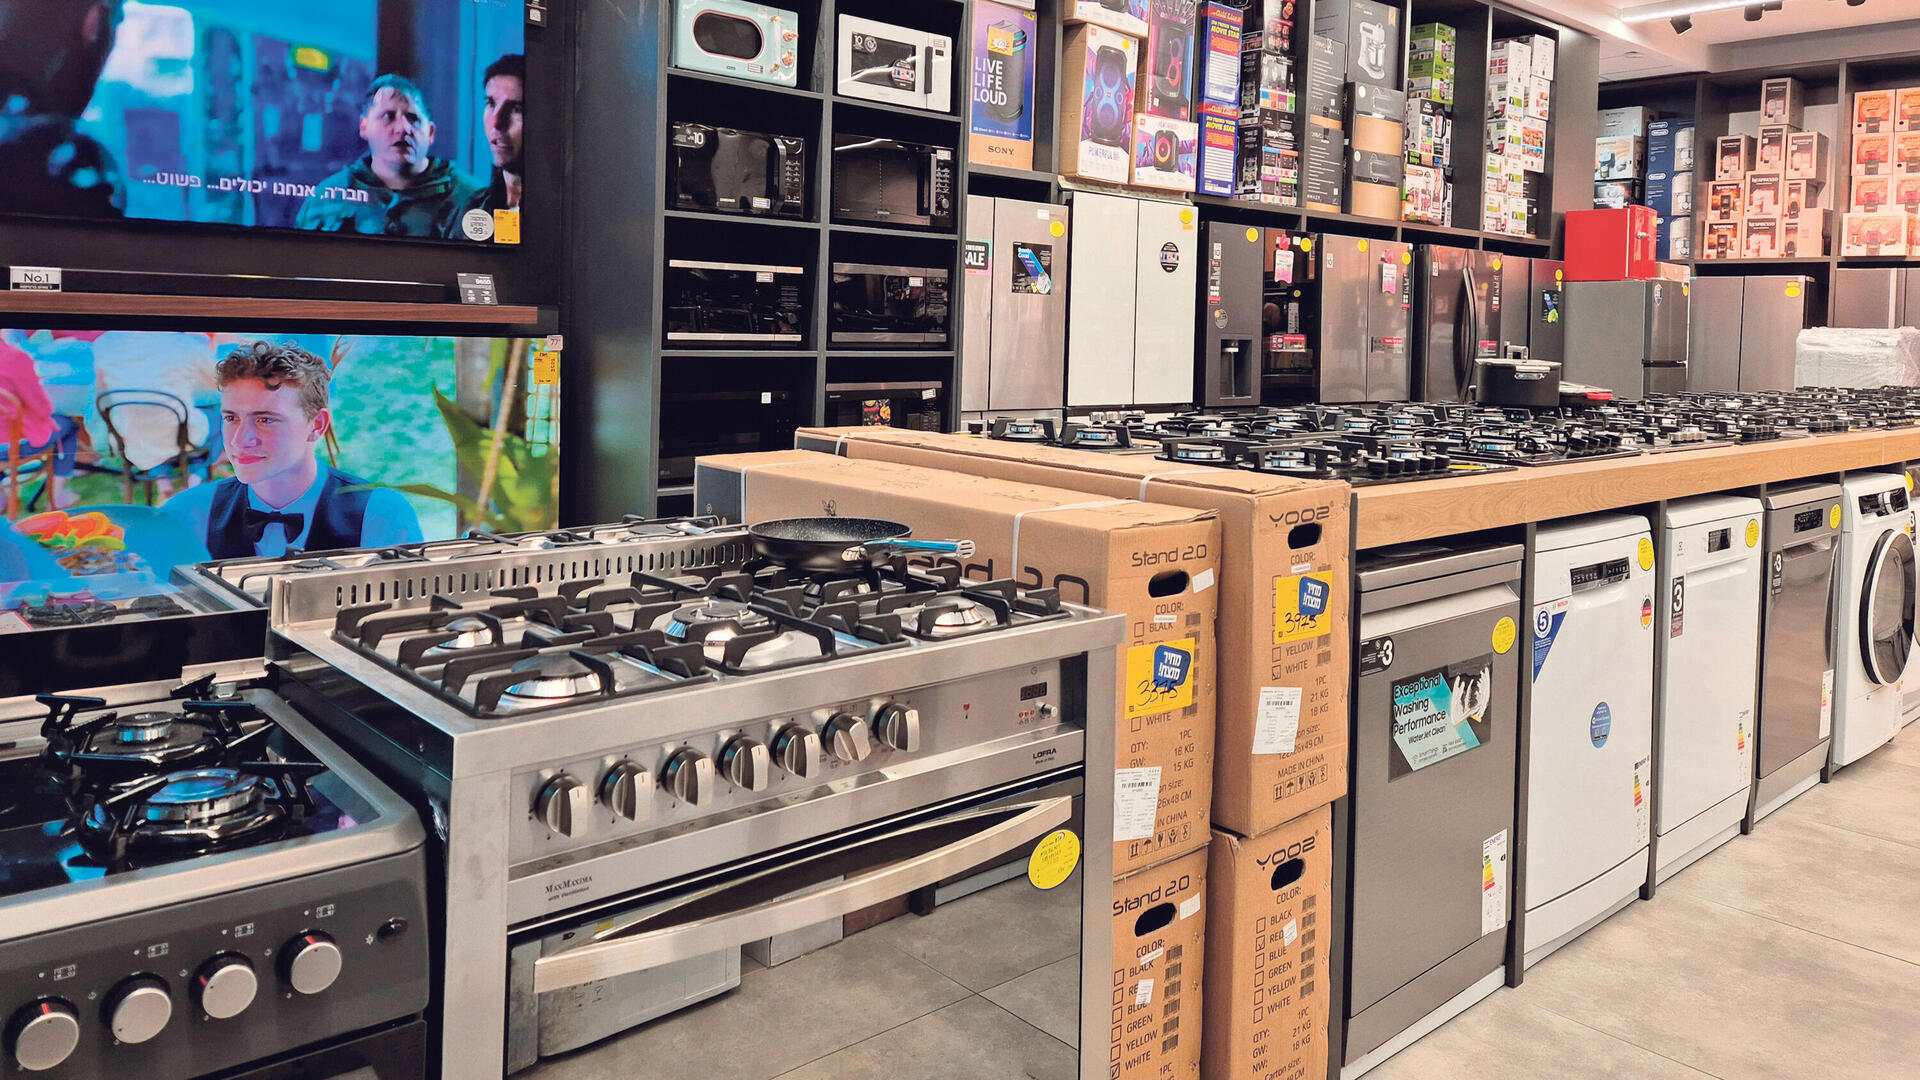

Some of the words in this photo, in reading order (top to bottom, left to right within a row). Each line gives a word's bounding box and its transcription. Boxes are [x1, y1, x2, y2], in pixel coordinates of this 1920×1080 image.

[854, 35, 863, 45] 10
[974, 56, 1004, 75] LIVE
[974, 72, 1003, 91] LIFE
[973, 89, 1008, 106] LOUD
[692, 132, 704, 145] 10
[988, 146, 1014, 156] SONY
[143, 171, 202, 188] פשוט...
[207, 176, 268, 194] יכולים...
[272, 181, 316, 197] אנחנו
[965, 244, 986, 252] AMSUNG
[24, 273, 49, 283] No.1
[1131, 547, 1178, 567] Stand
[1182, 544, 1208, 561] 2.0
[1290, 552, 1316, 566] COLOR:
[1775, 554, 1782, 572] 3
[1307, 582, 1322, 598] מחיר
[1673, 584, 1684, 612] 3
[1155, 602, 1184, 615] COLOR:
[1302, 593, 1321, 610] מנצח!
[1539, 612, 1547, 627] 5
[1149, 623, 1174, 633] BLACK
[1285, 640, 1314, 657] YELLOW
[1382, 639, 1393, 666] 3
[1163, 651, 1182, 667] מחיר
[1285, 659, 1309, 674] WHITE
[1158, 662, 1180, 680] מנצח!
[1315, 675, 1327, 687] 1PC
[1394, 673, 1442, 699] Exceptional
[1310, 692, 1318, 703] 21
[1319, 688, 1329, 699] KG
[1310, 708, 1318, 717] 18
[1319, 703, 1329, 714] KG
[1393, 697, 1429, 718] Washing
[1146, 712, 1172, 726] WHITE
[1393, 710, 1447, 737] Performance
[1179, 729, 1192, 740] 1PC
[1306, 723, 1321, 736] size:
[1130, 741, 1149, 754] QTY:
[1184, 743, 1195, 754] KG
[1313, 735, 1324, 747] CM
[1032, 748, 1057, 759] LOFRA
[1129, 758, 1146, 769] GW:
[1173, 762, 1182, 772] 15
[1183, 758, 1194, 769] KG
[1277, 765, 1298, 779] MADE
[1298, 762, 1305, 771] IN
[1305, 753, 1325, 768] CHINA
[1168, 779, 1184, 792] size:
[1180, 790, 1192, 802] CM
[1166, 811, 1188, 825] CHINA
[1112, 885, 1162, 917] Stand
[1165, 875, 1190, 897] 2.0
[1276, 886, 1302, 905] COLOR:
[1270, 908, 1293, 926] BLACK
[1269, 929, 1284, 943] RED
[1136, 939, 1165, 958] COLOR:
[1269, 946, 1287, 961] BLUE
[1129, 961, 1154, 978] BLACK
[1268, 961, 1293, 979] GREEN
[1128, 984, 1139, 996] RE
[1268, 976, 1297, 997] YELLOW
[1267, 996, 1292, 1015] WHITE
[1297, 1007, 1309, 1019] 1PC
[1126, 1014, 1153, 1033] GREEN
[1253, 1028, 1270, 1044] QTY:
[1292, 1026, 1300, 1038] 21
[1301, 1019, 1312, 1031] KG
[1126, 1029, 1158, 1052] YELLOW
[1252, 1044, 1269, 1059] GW:
[1292, 1040, 1300, 1052] 18
[1301, 1034, 1311, 1047] KG
[1125, 1050, 1151, 1071] WHITE
[1252, 1059, 1269, 1074] NW:
[1264, 1065, 1287, 1080] Carton
[1287, 1057, 1302, 1070] size:
[1160, 1062, 1173, 1076] 1PC
[1294, 1067, 1305, 1079] CM
